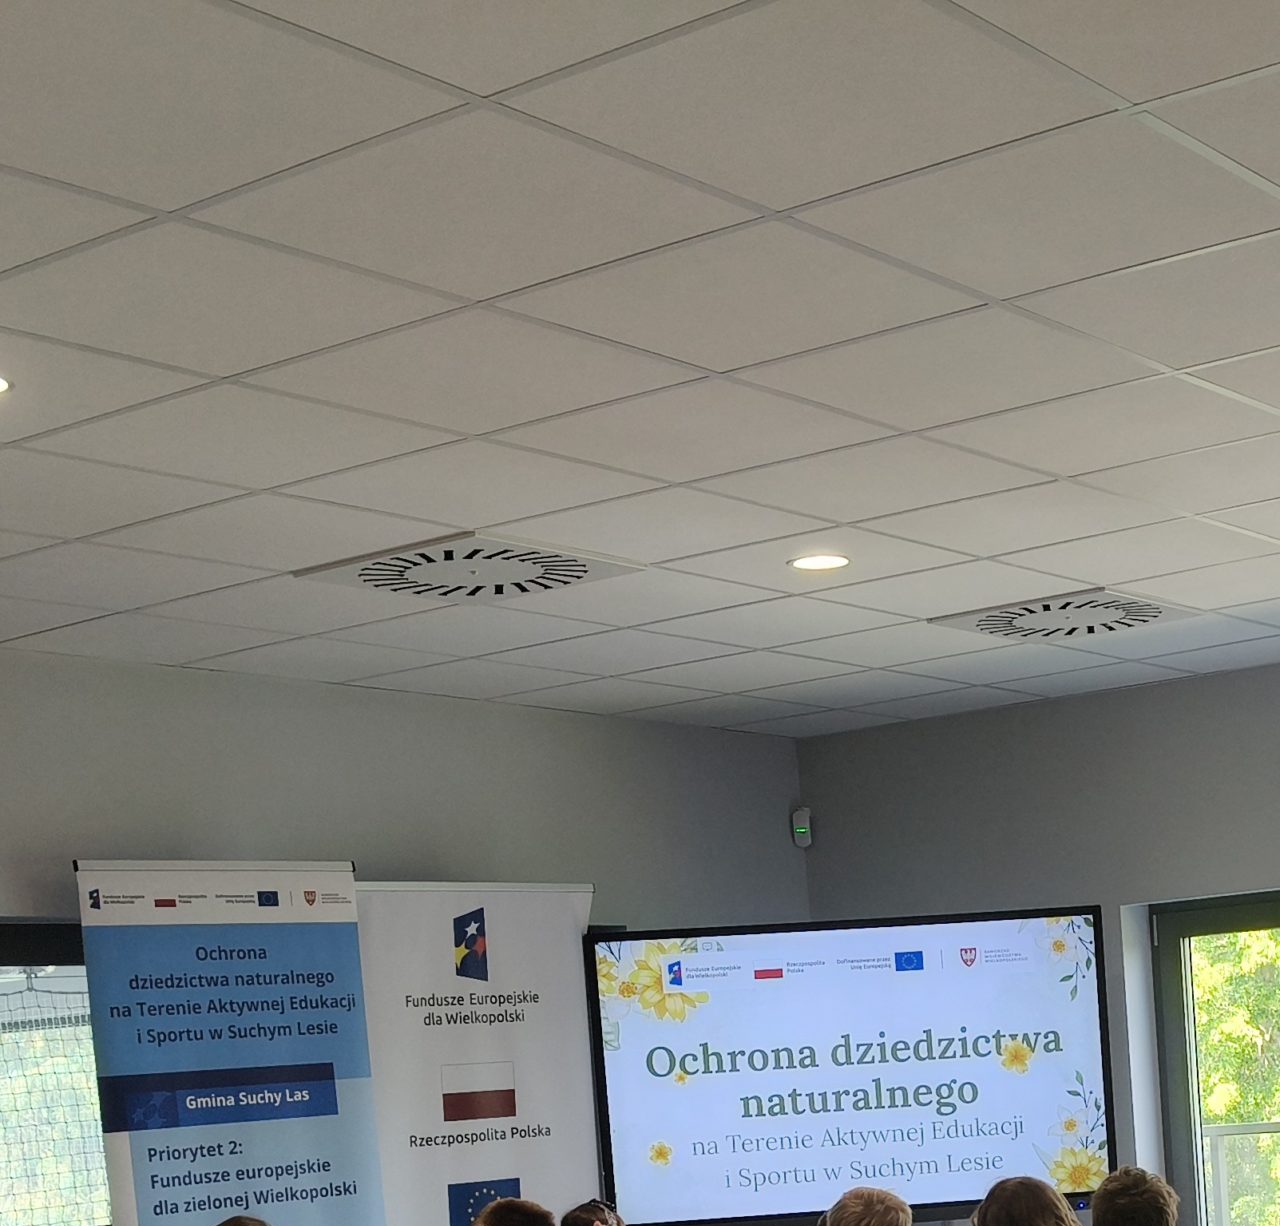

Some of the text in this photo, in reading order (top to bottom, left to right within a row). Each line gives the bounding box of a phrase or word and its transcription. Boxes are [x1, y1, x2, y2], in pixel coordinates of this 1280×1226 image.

[196, 946, 267, 961] Ochrona
[129, 970, 334, 989] dziedzictwa naturalnego
[110, 994, 355, 1018] na Terenie Aktywnej Edukacji
[406, 991, 539, 1007] Fundusze Europejskie
[424, 1009, 524, 1025] dla Wielkopolski
[137, 1020, 337, 1047] i Sportu w Suchym Lesie
[646, 1042, 819, 1077] Ochrona
[186, 1089, 309, 1108] Gmina Suchy Las
[740, 1078, 979, 1118] naturalnego
[410, 1124, 550, 1147] Rzeczpospolita Polska
[692, 1115, 1024, 1155] na Terenie Aktywnej Edukacji
[148, 1141, 242, 1163] Priorytet 2:
[151, 1159, 332, 1189] Fundusze europejskie
[725, 1154, 1004, 1192] i Sportu w Suchym Lesie
[153, 1181, 356, 1216] dla zielonej Wielkopolski
